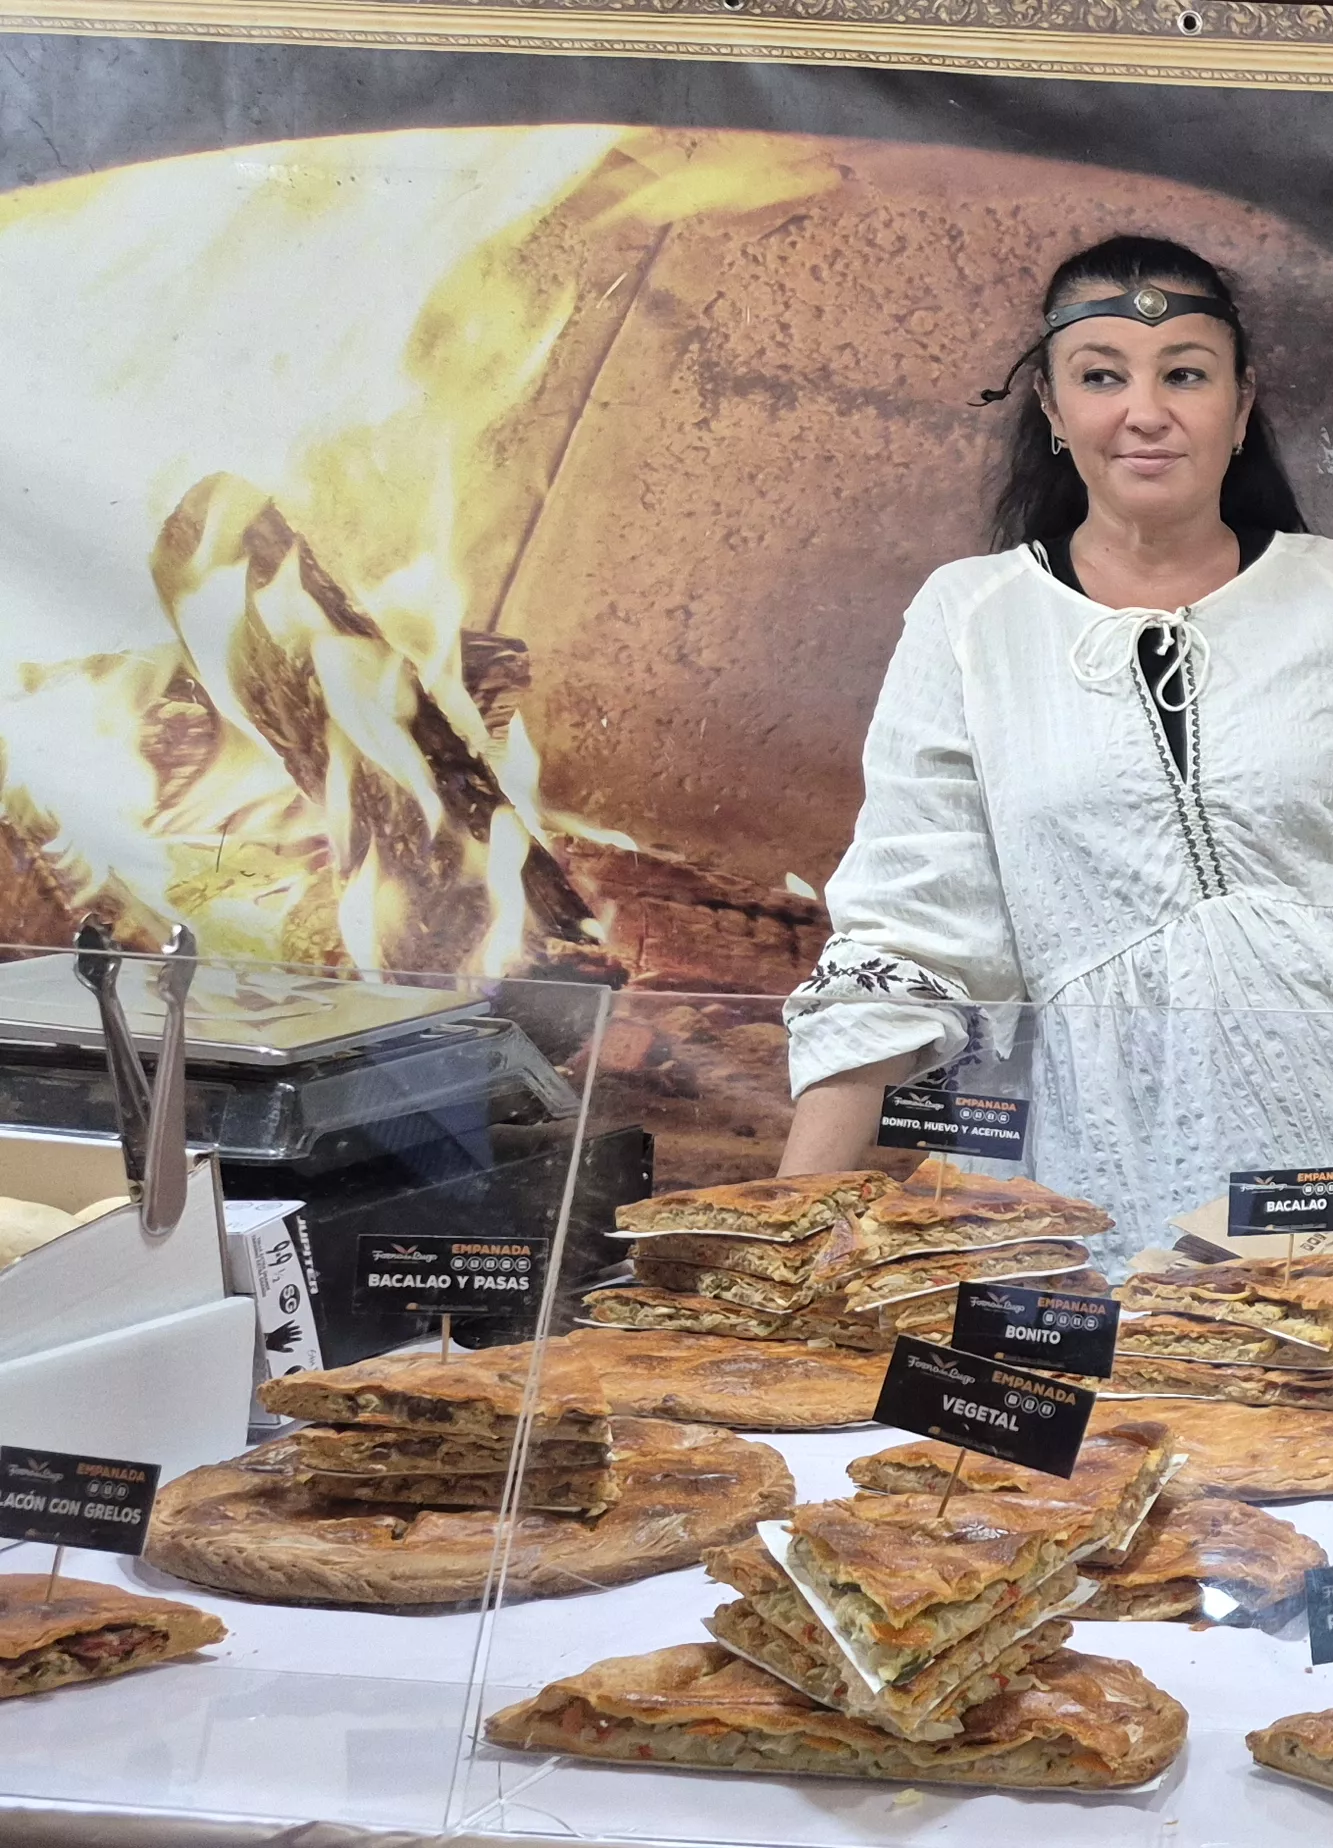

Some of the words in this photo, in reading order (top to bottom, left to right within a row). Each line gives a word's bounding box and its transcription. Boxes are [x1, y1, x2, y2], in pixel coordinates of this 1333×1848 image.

[955, 1097, 1017, 1112] EMPANADA
[924, 1122, 959, 1134] HUEVO
[961, 1125, 969, 1134] Y
[971, 1126, 1021, 1140] ACEITUNA
[1266, 1198, 1328, 1213] BACALAO
[296, 1215, 319, 1295] JUPITER
[451, 1243, 531, 1256] EMPANADA
[368, 1273, 451, 1289] BACALAO
[456, 1275, 469, 1289] Y
[473, 1275, 530, 1291] PASAS
[1037, 1296, 1106, 1315] EMPANADA
[1004, 1324, 1062, 1345] BONITO
[991, 1370, 1077, 1406] EMPANADA
[942, 1394, 1020, 1432] VEGETAL
[76, 1462, 147, 1483] EMPANADA
[49, 1498, 82, 1516] CON
[83, 1502, 142, 1525] GRELOS
